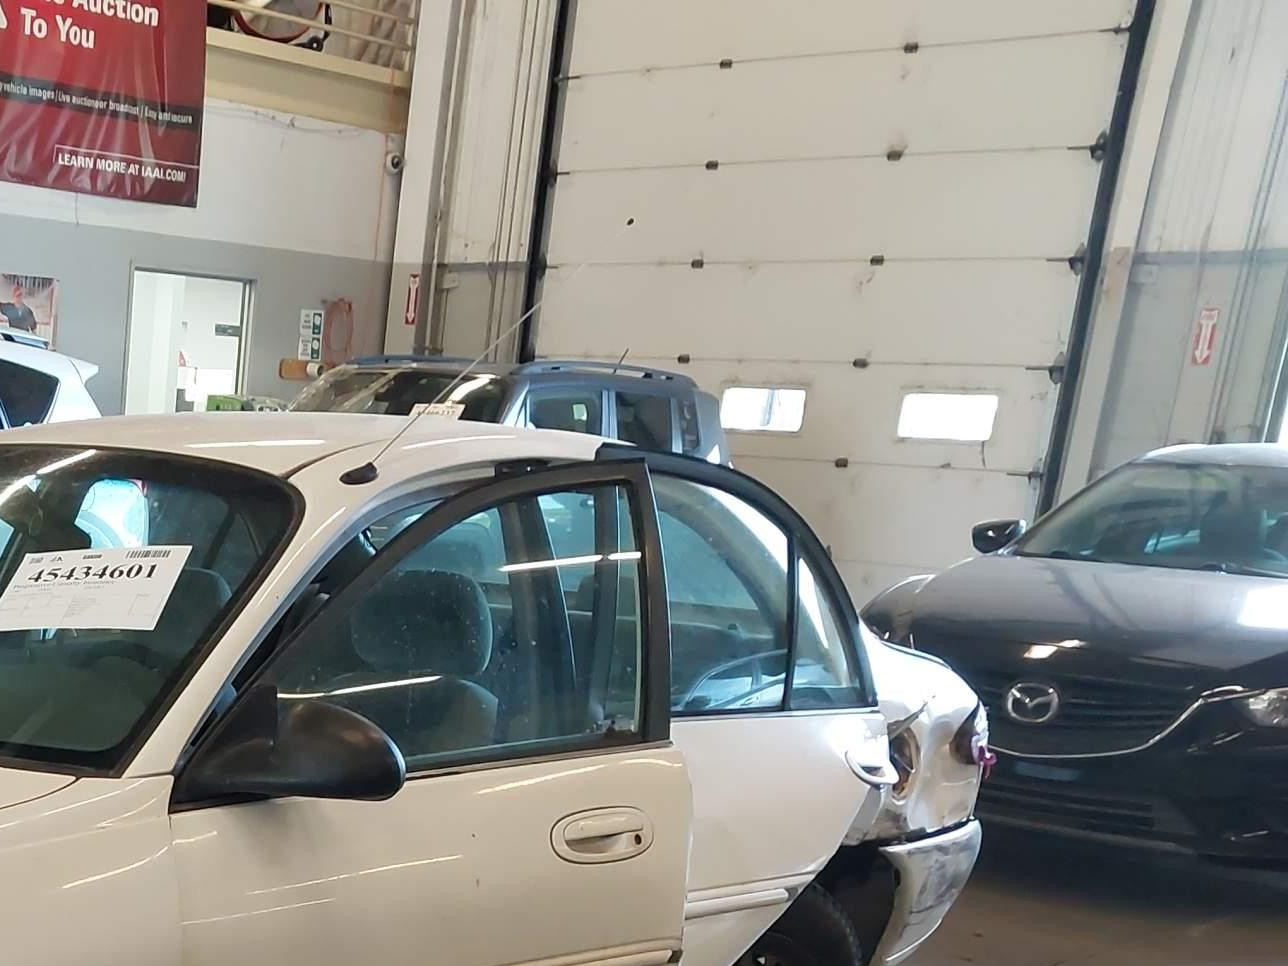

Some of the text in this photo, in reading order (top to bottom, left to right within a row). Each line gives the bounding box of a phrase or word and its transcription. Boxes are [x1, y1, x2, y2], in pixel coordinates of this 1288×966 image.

[20, 7, 95, 49] To You
[28, 85, 54, 100] images
[58, 152, 94, 169] LEARN
[95, 158, 128, 174] MORE
[127, 163, 140, 176] AT
[28, 563, 158, 583] 45434601
